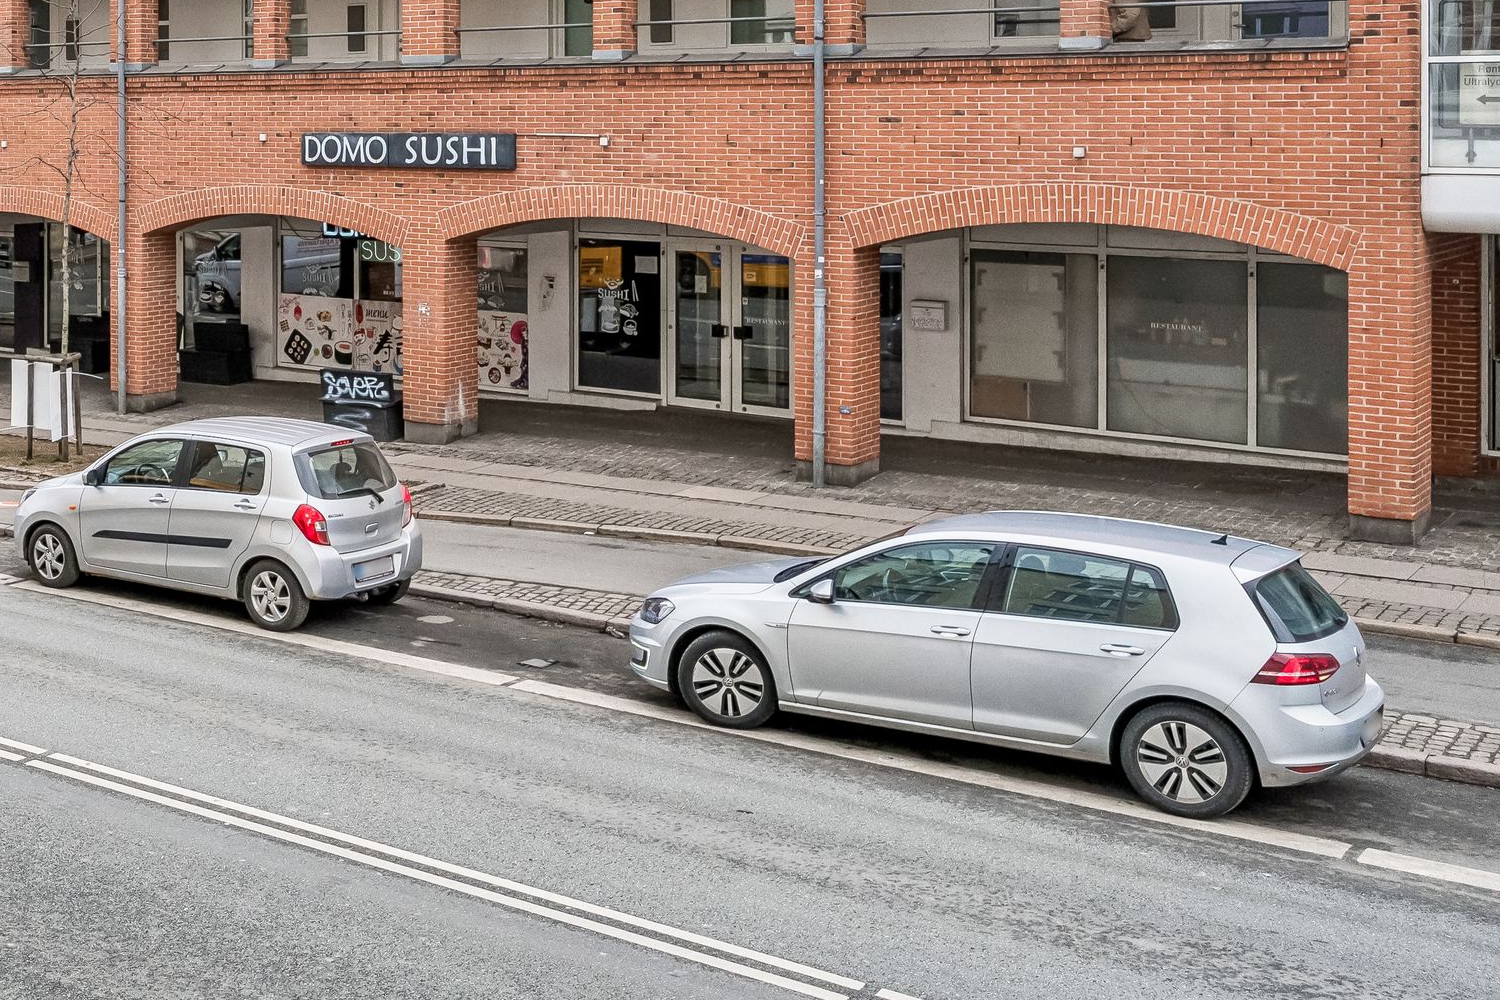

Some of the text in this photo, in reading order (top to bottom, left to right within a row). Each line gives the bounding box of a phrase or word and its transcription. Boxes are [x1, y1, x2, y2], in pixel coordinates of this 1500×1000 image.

[304, 135, 498, 166] DOMO SUSHI
[597, 287, 630, 301] SUSHI
[365, 308, 390, 320] menu
[1149, 322, 1203, 332] RESTAURANT
